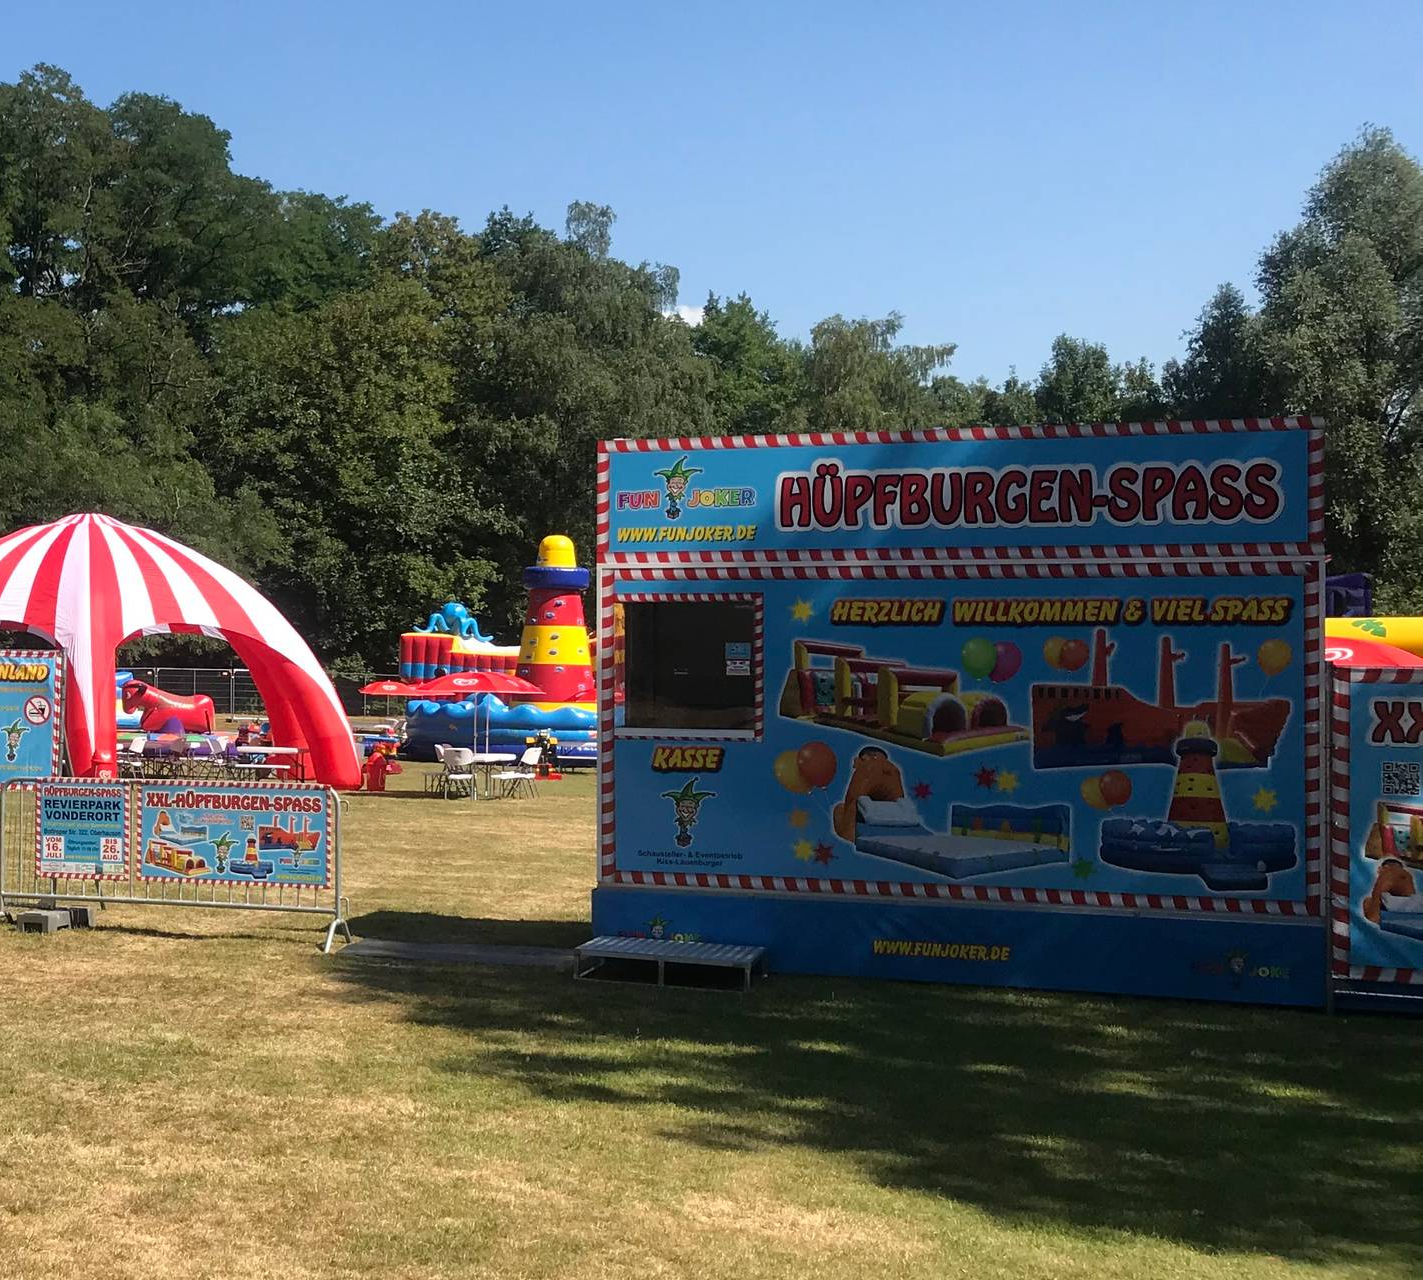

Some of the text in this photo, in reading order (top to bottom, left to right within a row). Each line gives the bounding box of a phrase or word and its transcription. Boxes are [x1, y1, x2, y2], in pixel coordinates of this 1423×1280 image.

[617, 488, 755, 510] FUN JOKER
[779, 463, 1280, 528] HÜPFBURGEN-SPASS
[617, 525, 757, 543] WWW.FUNJOKER.DE
[831, 598, 1288, 624] HERZLICH WILLKOMMEN & VIEL SPASS
[652, 746, 721, 771] KASSE
[44, 785, 122, 798] HÜPFBURGEN-SPASS
[146, 790, 322, 813] XXL-HÜPFBURGEN-SPASS
[44, 799, 122, 811] REVIERPARK
[45, 810, 121, 822] VONDERORT
[45, 843, 62, 852] 16.
[103, 845, 120, 854] 26.
[873, 939, 1010, 961] WWW.FUNJOKER.DE
